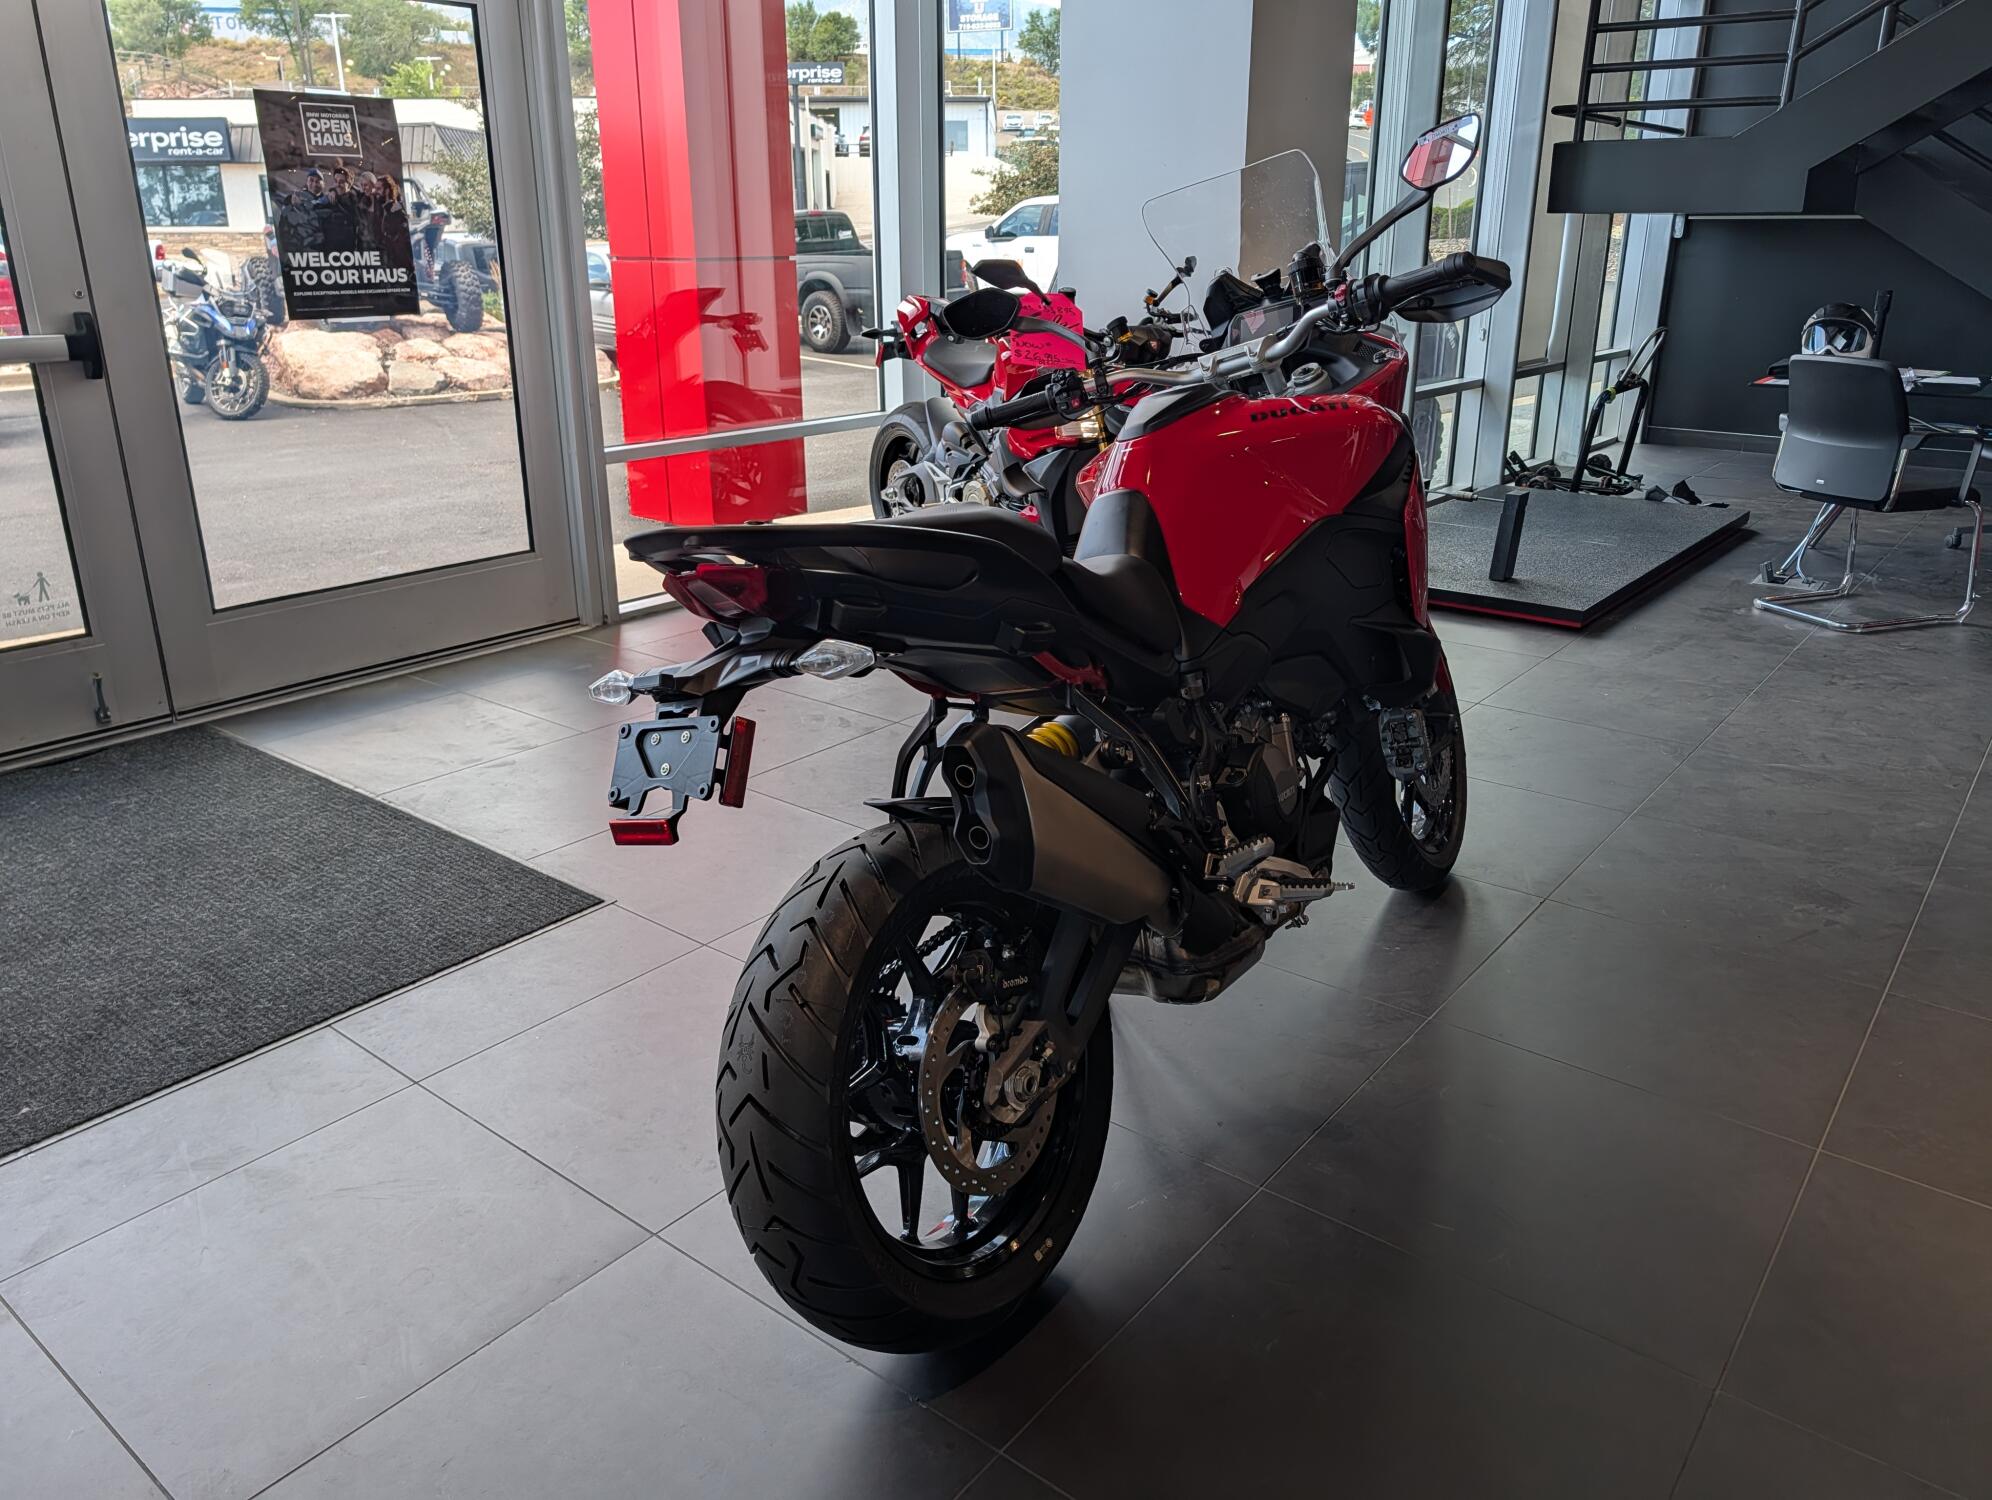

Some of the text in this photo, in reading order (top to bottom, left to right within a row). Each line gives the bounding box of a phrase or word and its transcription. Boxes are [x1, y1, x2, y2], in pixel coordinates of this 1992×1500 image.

[307, 118, 352, 133] OPEN
[310, 132, 353, 146] HAUS
[168, 147, 224, 155] rent-a-car
[288, 251, 382, 268] WELCOME
[290, 267, 408, 286] TO OUR HAUS
[1251, 402, 1349, 421] DUCATI
[1002, 975, 1029, 989] brembo
